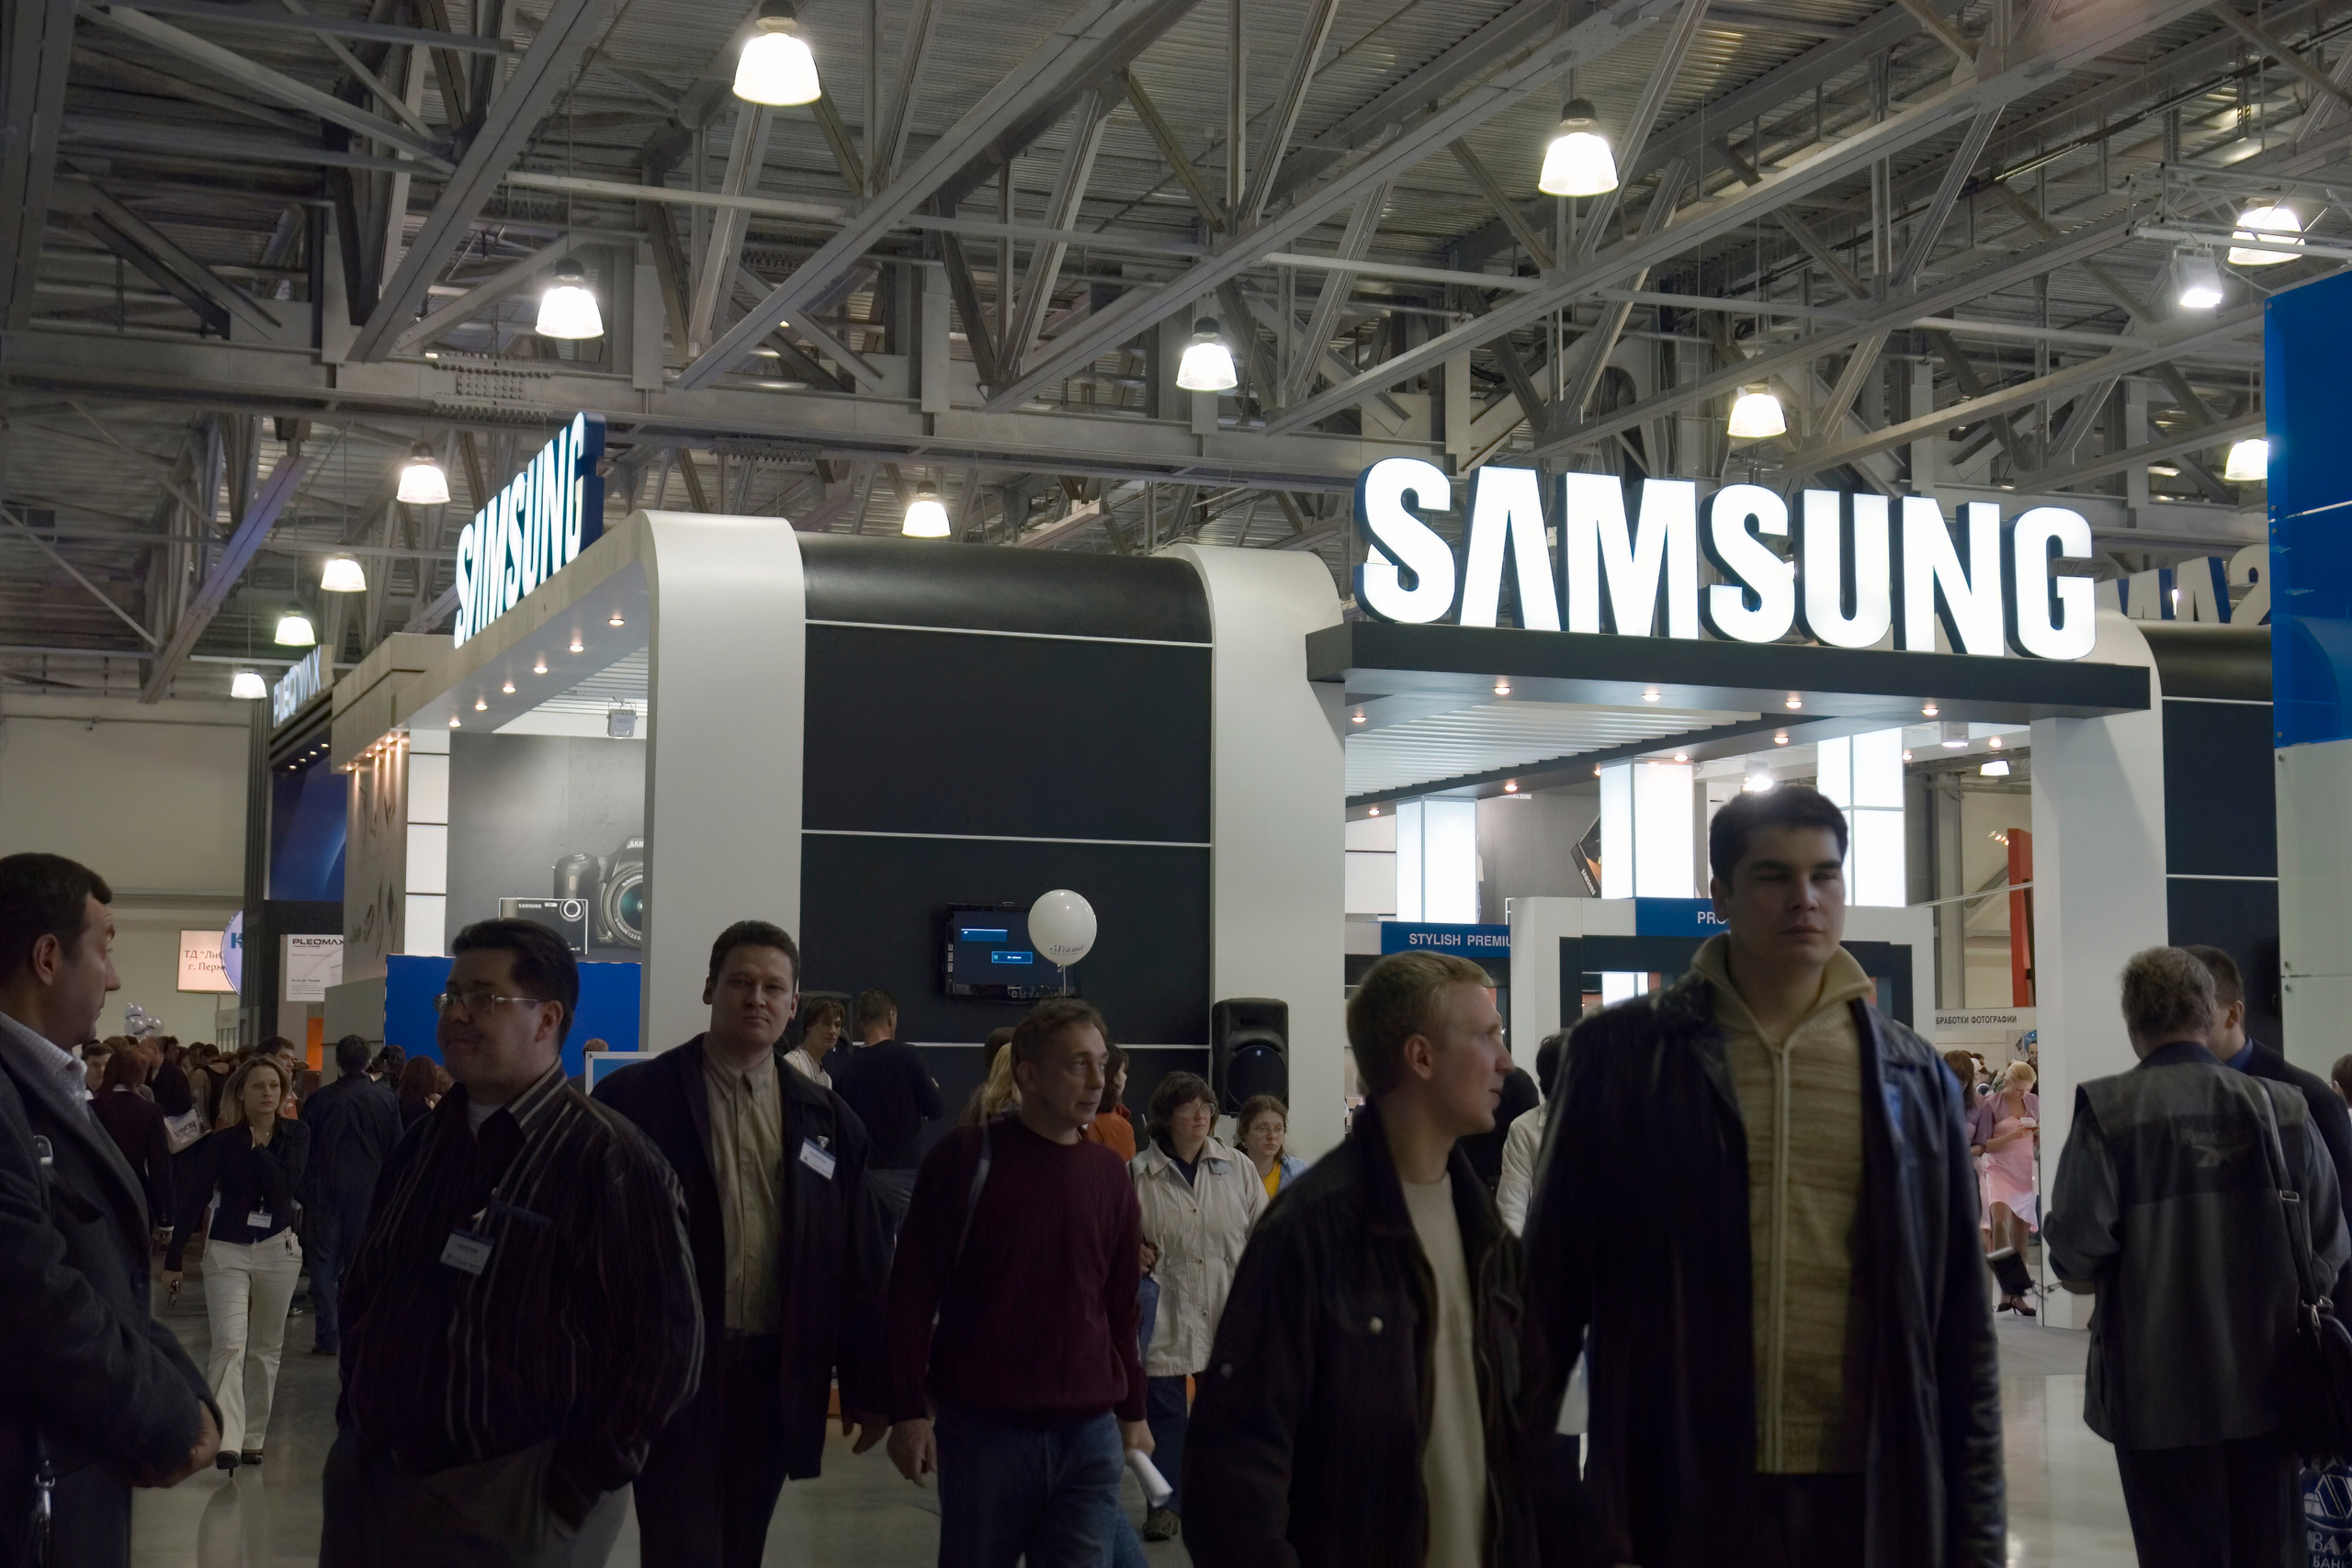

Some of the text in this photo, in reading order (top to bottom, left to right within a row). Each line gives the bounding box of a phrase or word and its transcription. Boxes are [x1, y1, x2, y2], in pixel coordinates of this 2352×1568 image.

[453, 411, 586, 649] SAMSUNG
[1355, 457, 2097, 660] SAMSUNG
[1580, 868, 1597, 896] SAMSUNG
[1408, 933, 1461, 946] STYLISH
[184, 950, 198, 960] ТД
[1971, 1015, 2018, 1024] ФОТОГРАФИИ
